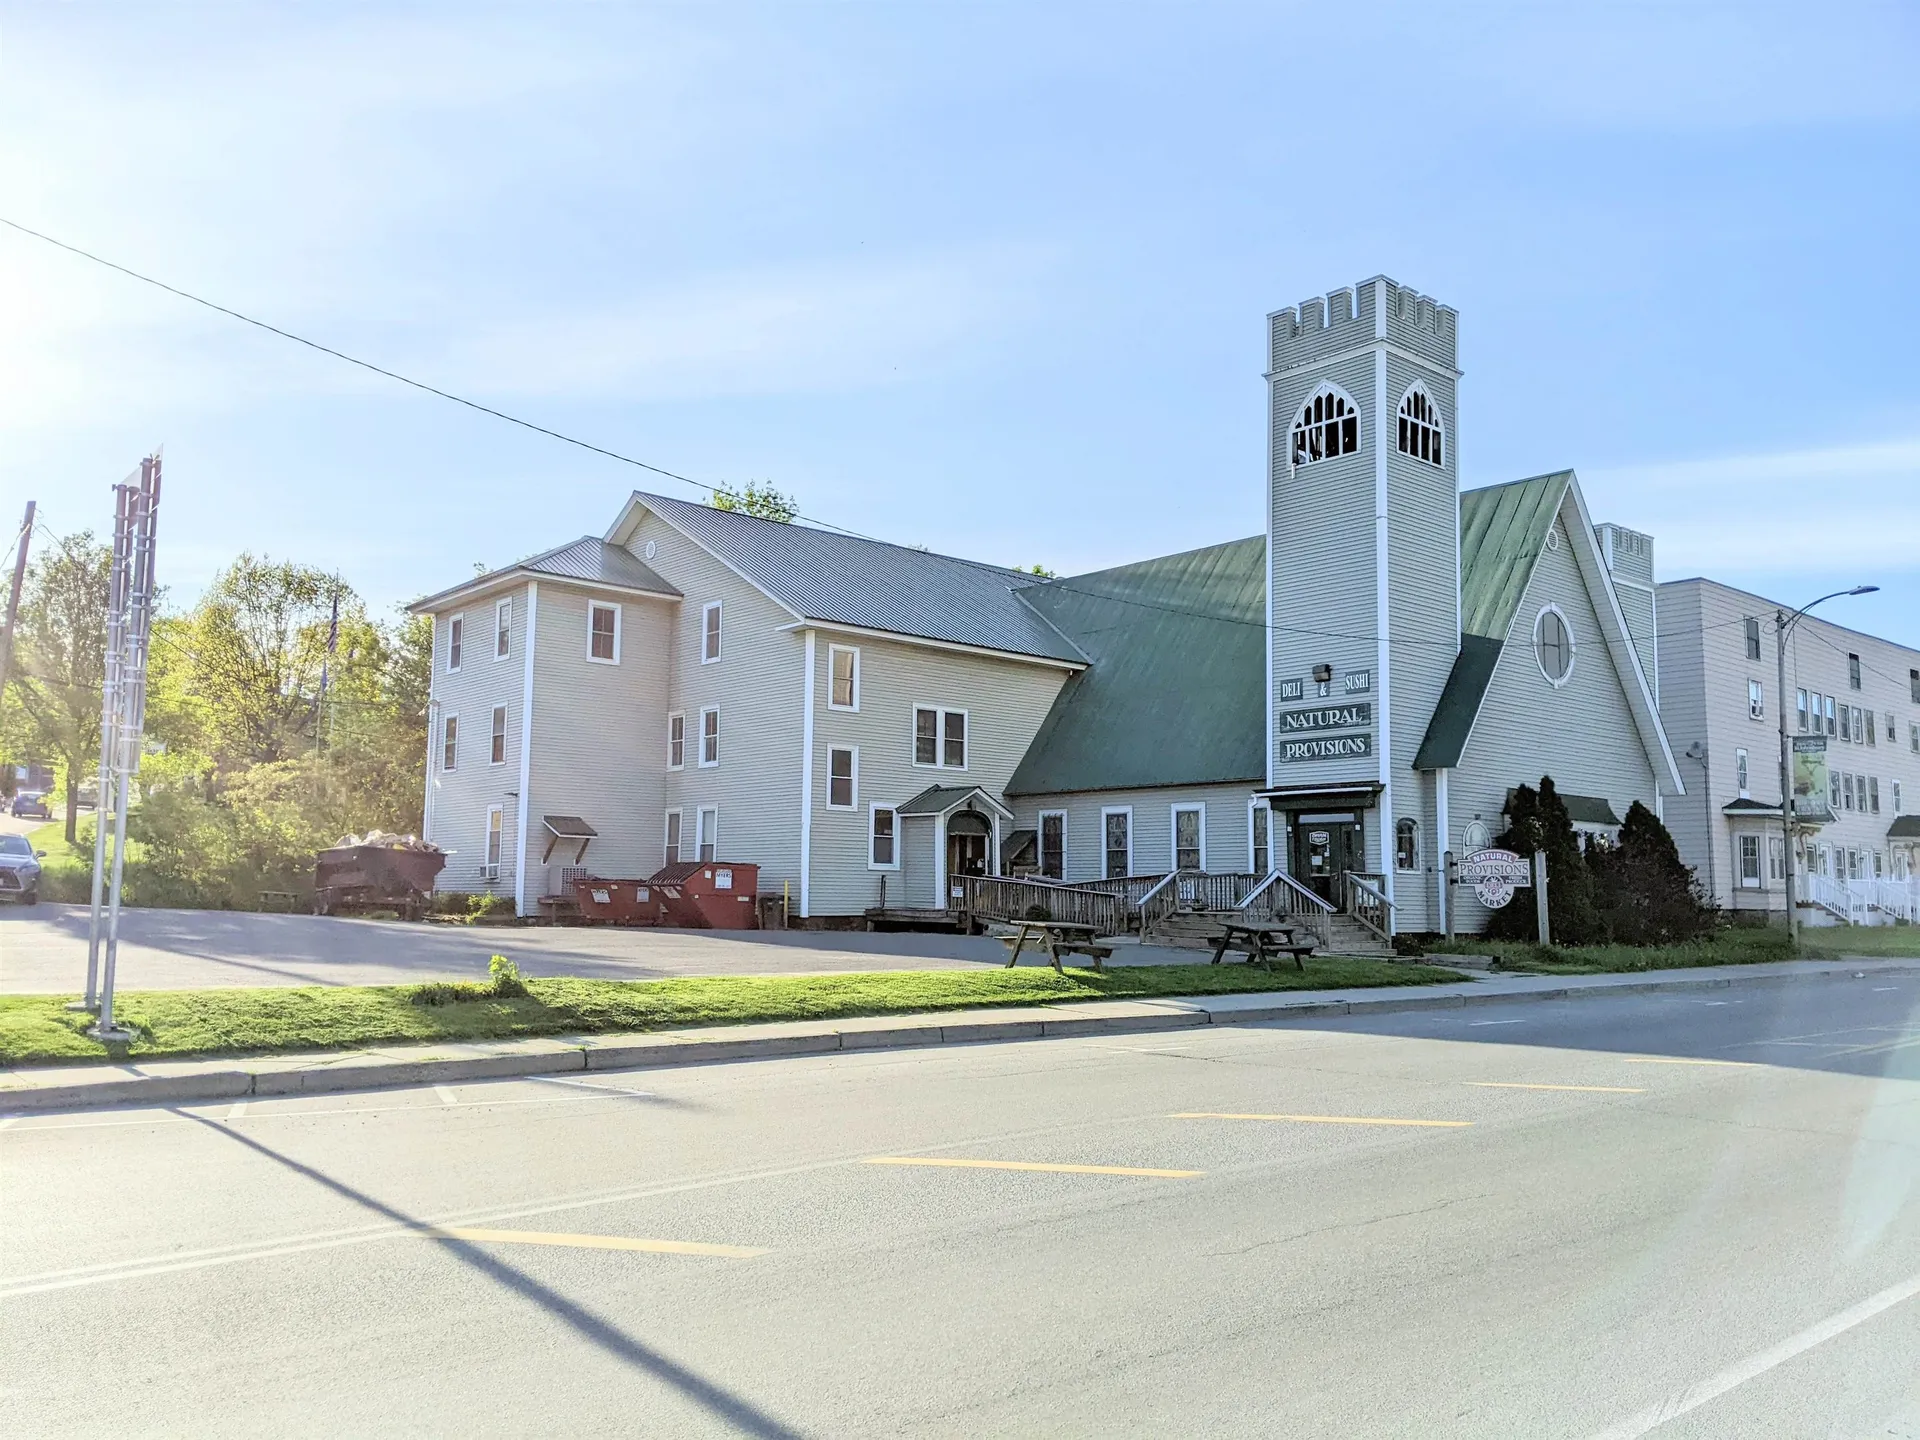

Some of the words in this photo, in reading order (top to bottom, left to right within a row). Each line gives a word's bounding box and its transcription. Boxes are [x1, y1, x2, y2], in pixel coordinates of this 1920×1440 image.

[1282, 682, 1301, 697] DELI
[1320, 682, 1327, 696] &
[1345, 673, 1369, 690] SUSHI
[1286, 707, 1363, 729] NATURAL
[1285, 738, 1366, 758] PROVISIONS
[1473, 853, 1513, 863] NATURAL
[1460, 864, 1528, 875] PROVISIONS
[1477, 890, 1512, 907] MARKET
